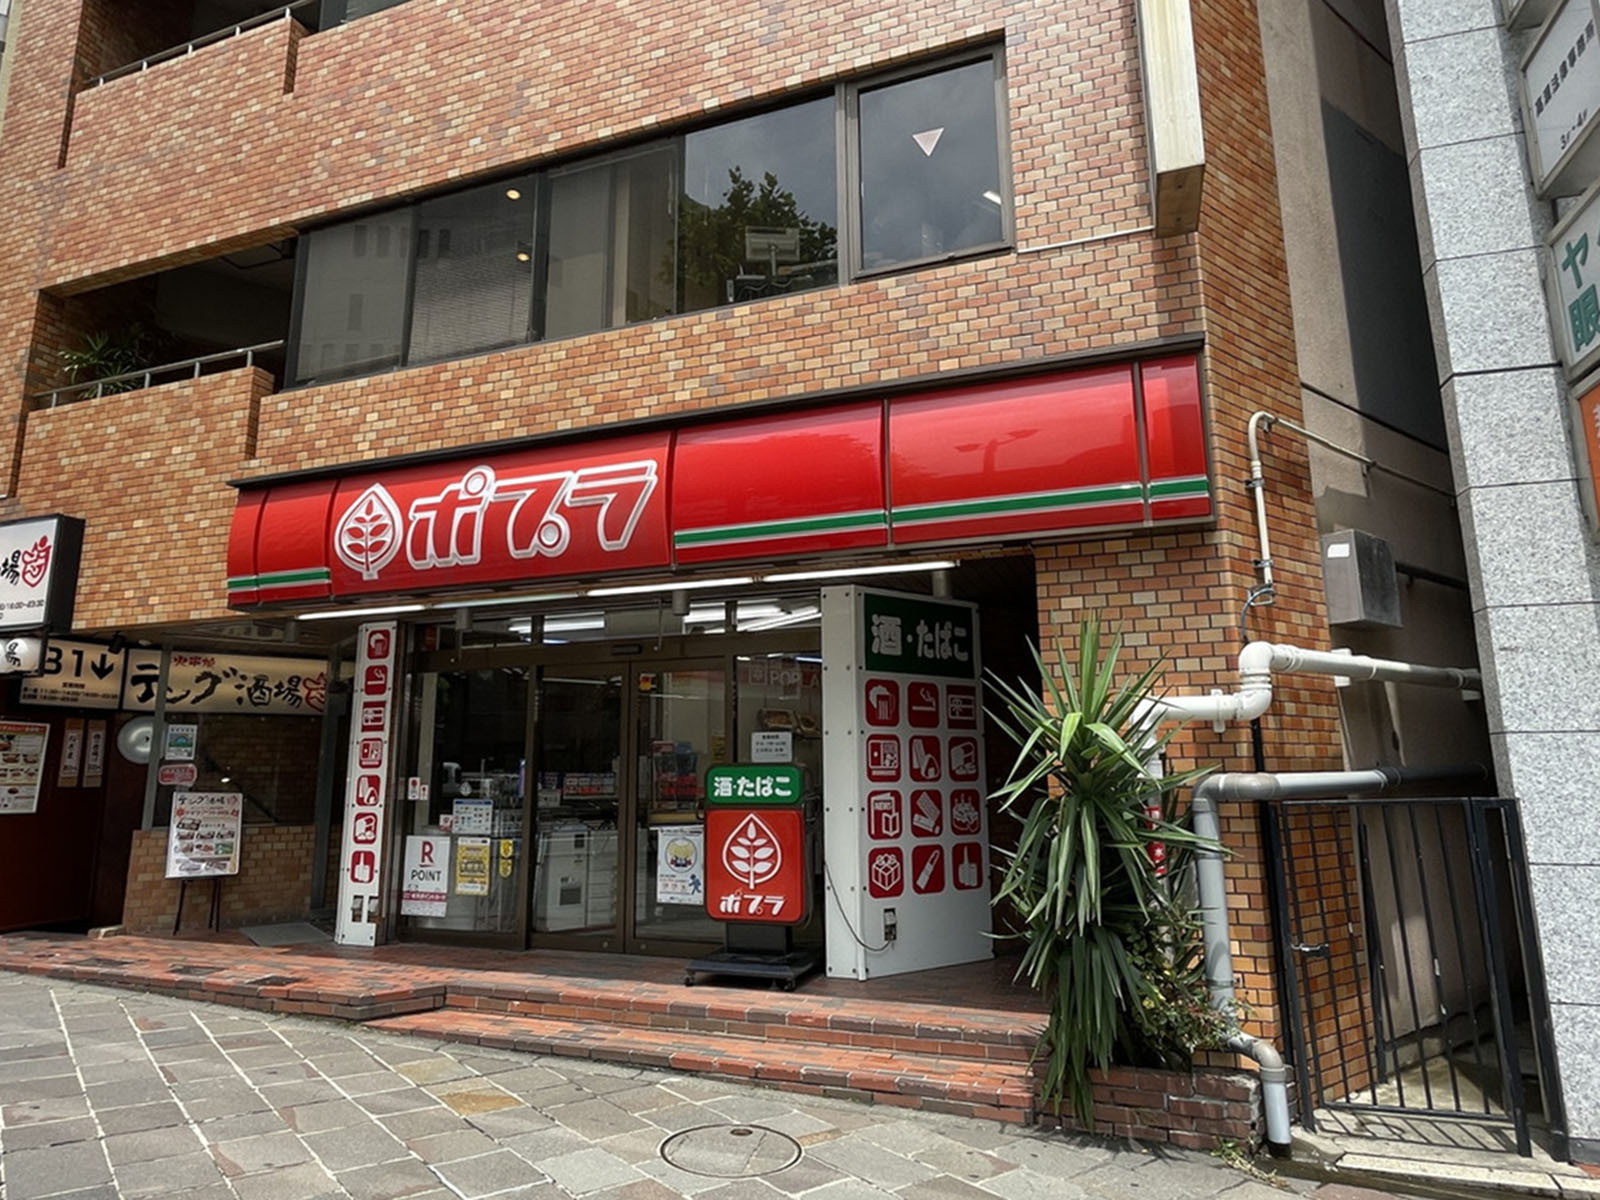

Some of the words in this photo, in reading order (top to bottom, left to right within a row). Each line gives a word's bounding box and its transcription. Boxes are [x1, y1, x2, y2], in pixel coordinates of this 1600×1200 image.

[407, 461, 657, 570] ポプラ
[871, 613, 969, 662] 酒・たばこ
[713, 776, 792, 797] 酒・たばこ
[420, 841, 434, 863] R
[406, 870, 442, 881] POINT
[719, 887, 786, 916] ポプラ
